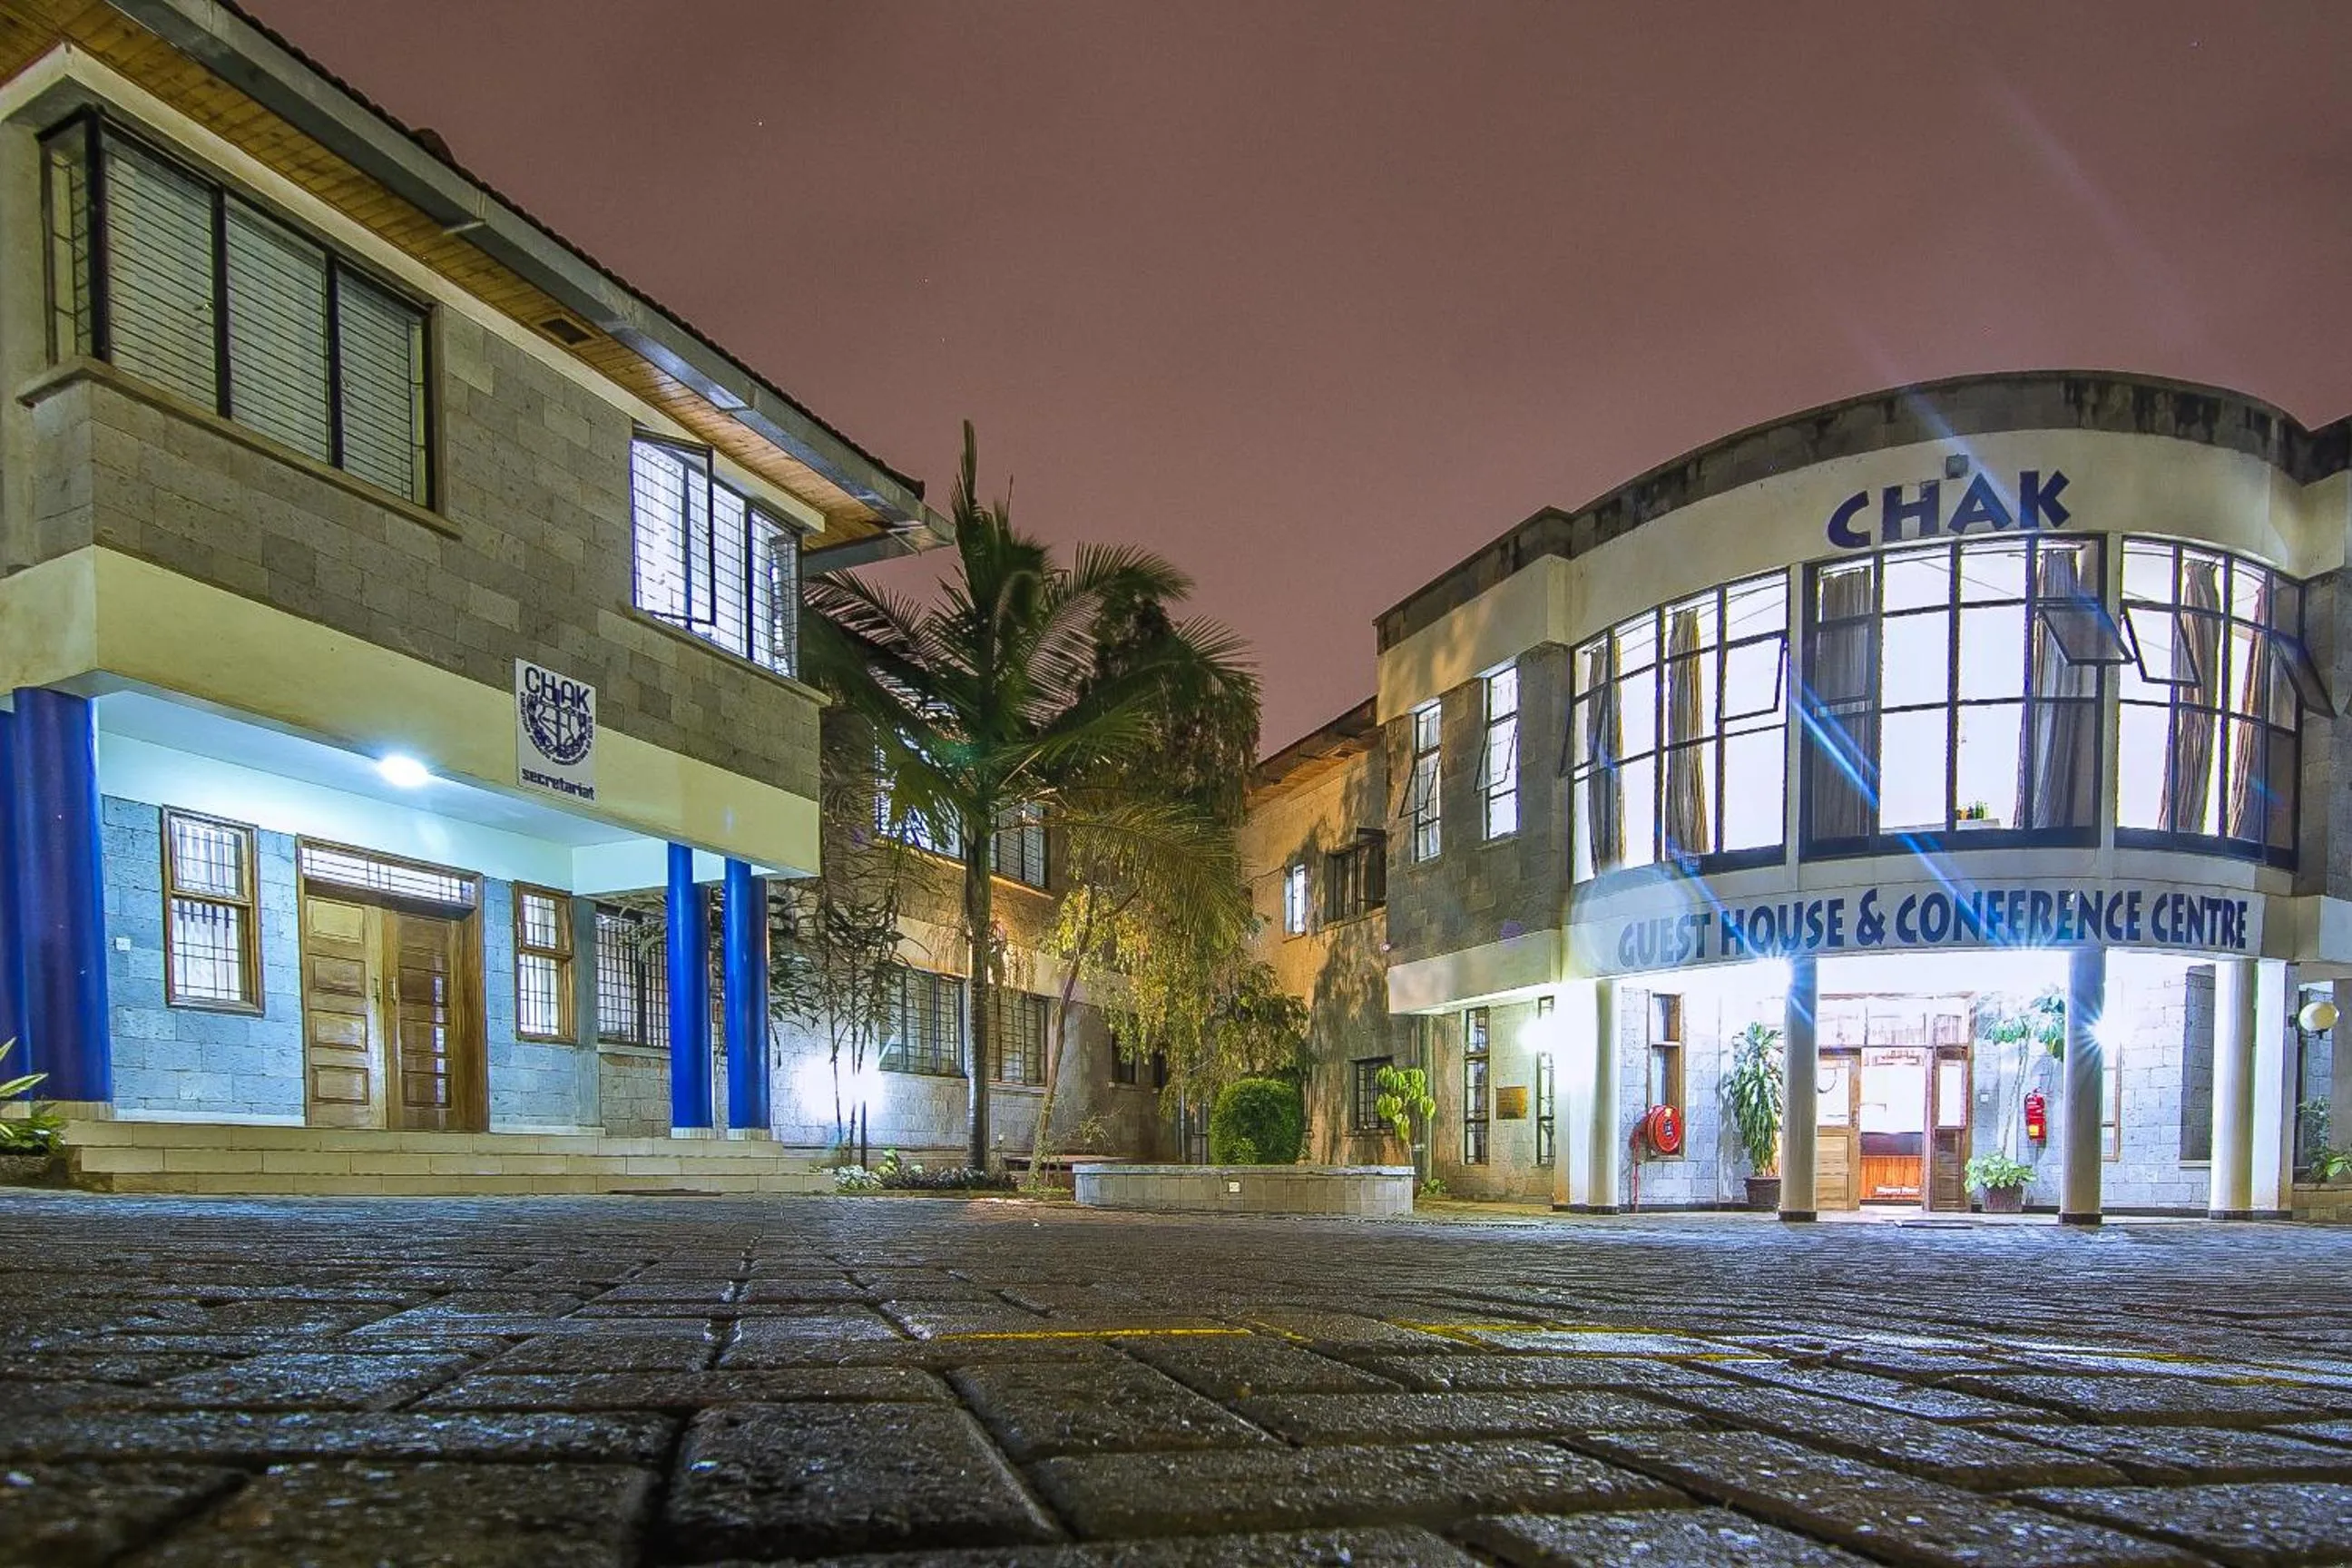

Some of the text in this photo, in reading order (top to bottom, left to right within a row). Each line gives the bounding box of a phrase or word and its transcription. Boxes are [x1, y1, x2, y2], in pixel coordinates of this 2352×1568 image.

[1828, 470, 2071, 548] CHAK
[525, 667, 590, 712] CHAK
[522, 768, 595, 800] secretariat
[1618, 888, 2248, 967] GUEST HOUSE & CONFERENCE CENTRE
